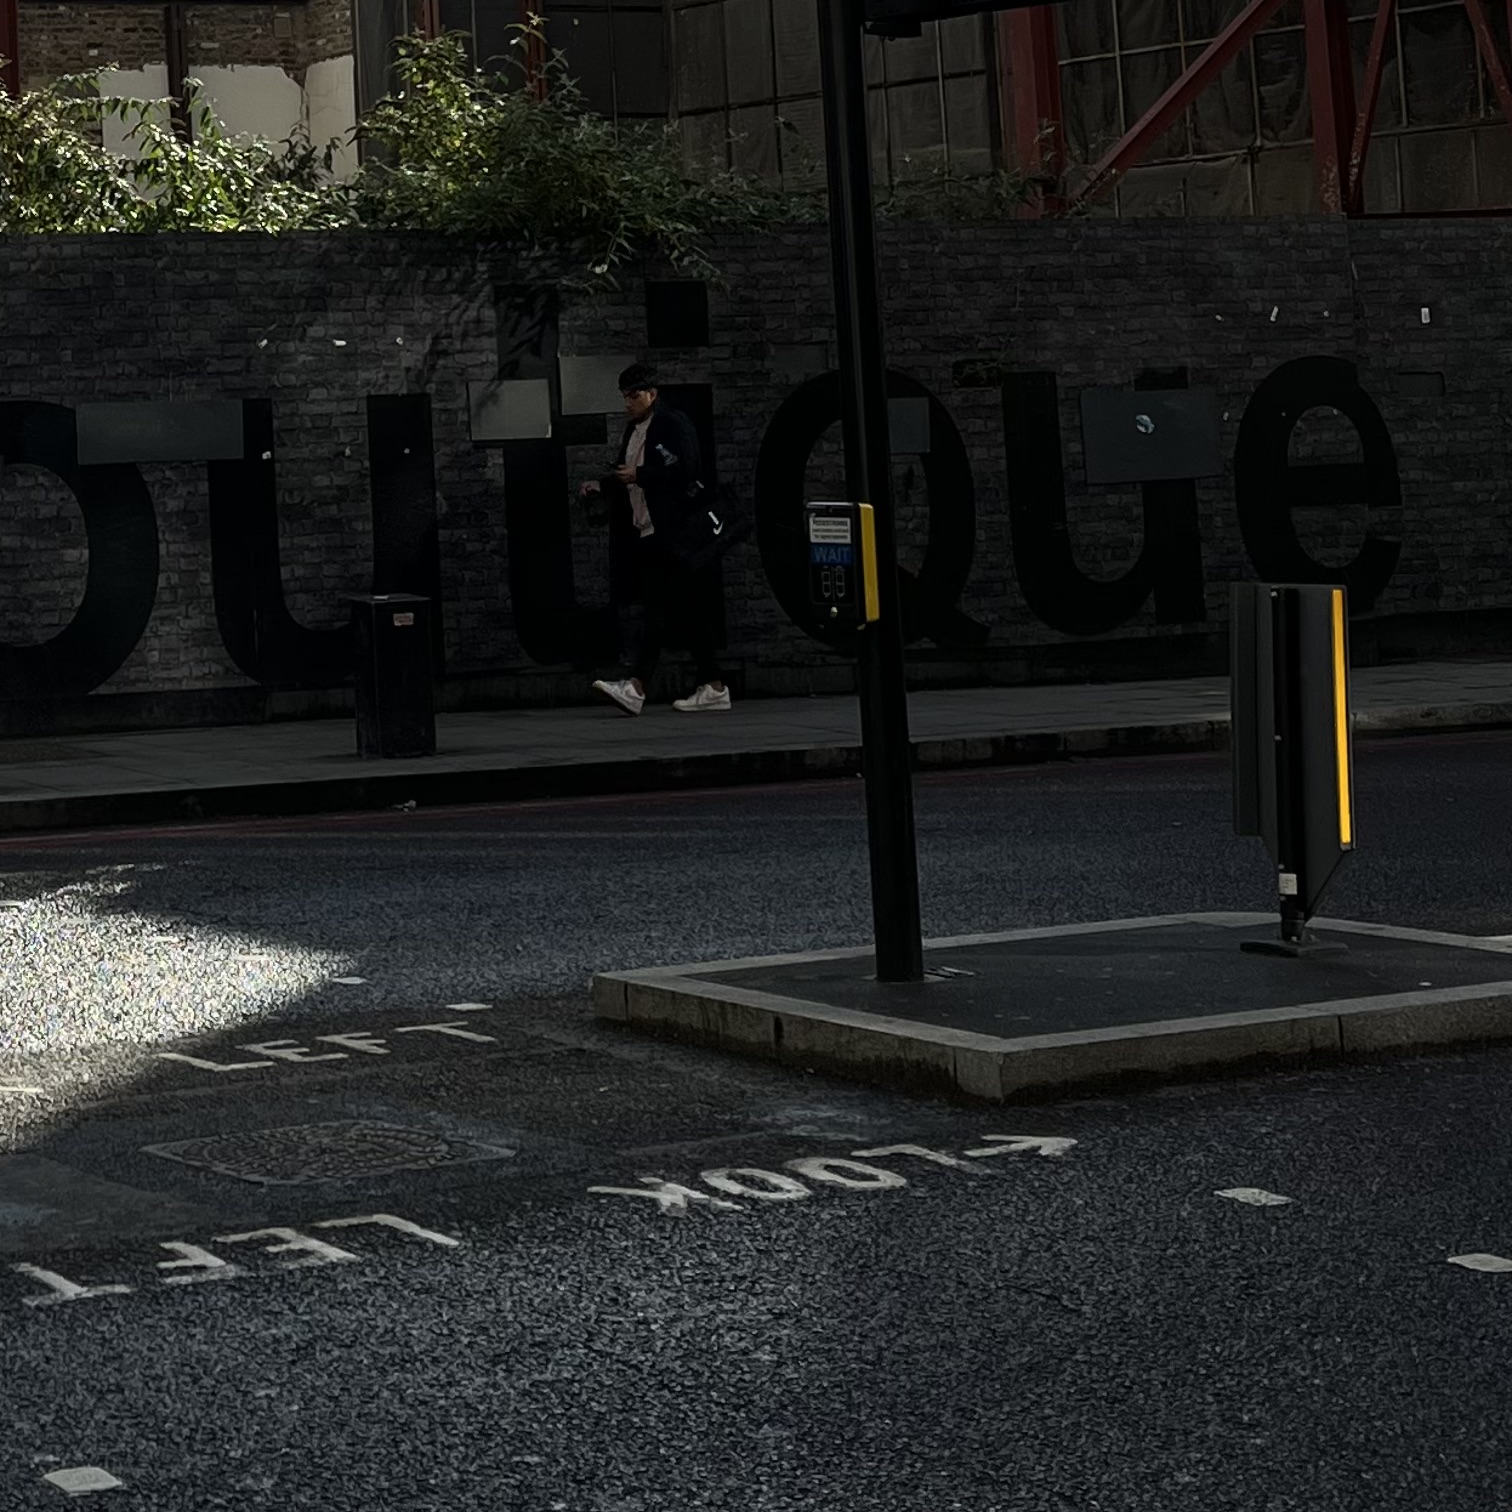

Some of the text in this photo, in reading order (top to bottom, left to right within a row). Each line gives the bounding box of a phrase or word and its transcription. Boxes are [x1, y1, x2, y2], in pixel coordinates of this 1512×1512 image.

[814, 546, 851, 563] WAIT
[153, 1011, 498, 1072] LEFT
[8, 1143, 990, 1307] LOOK LEFT
